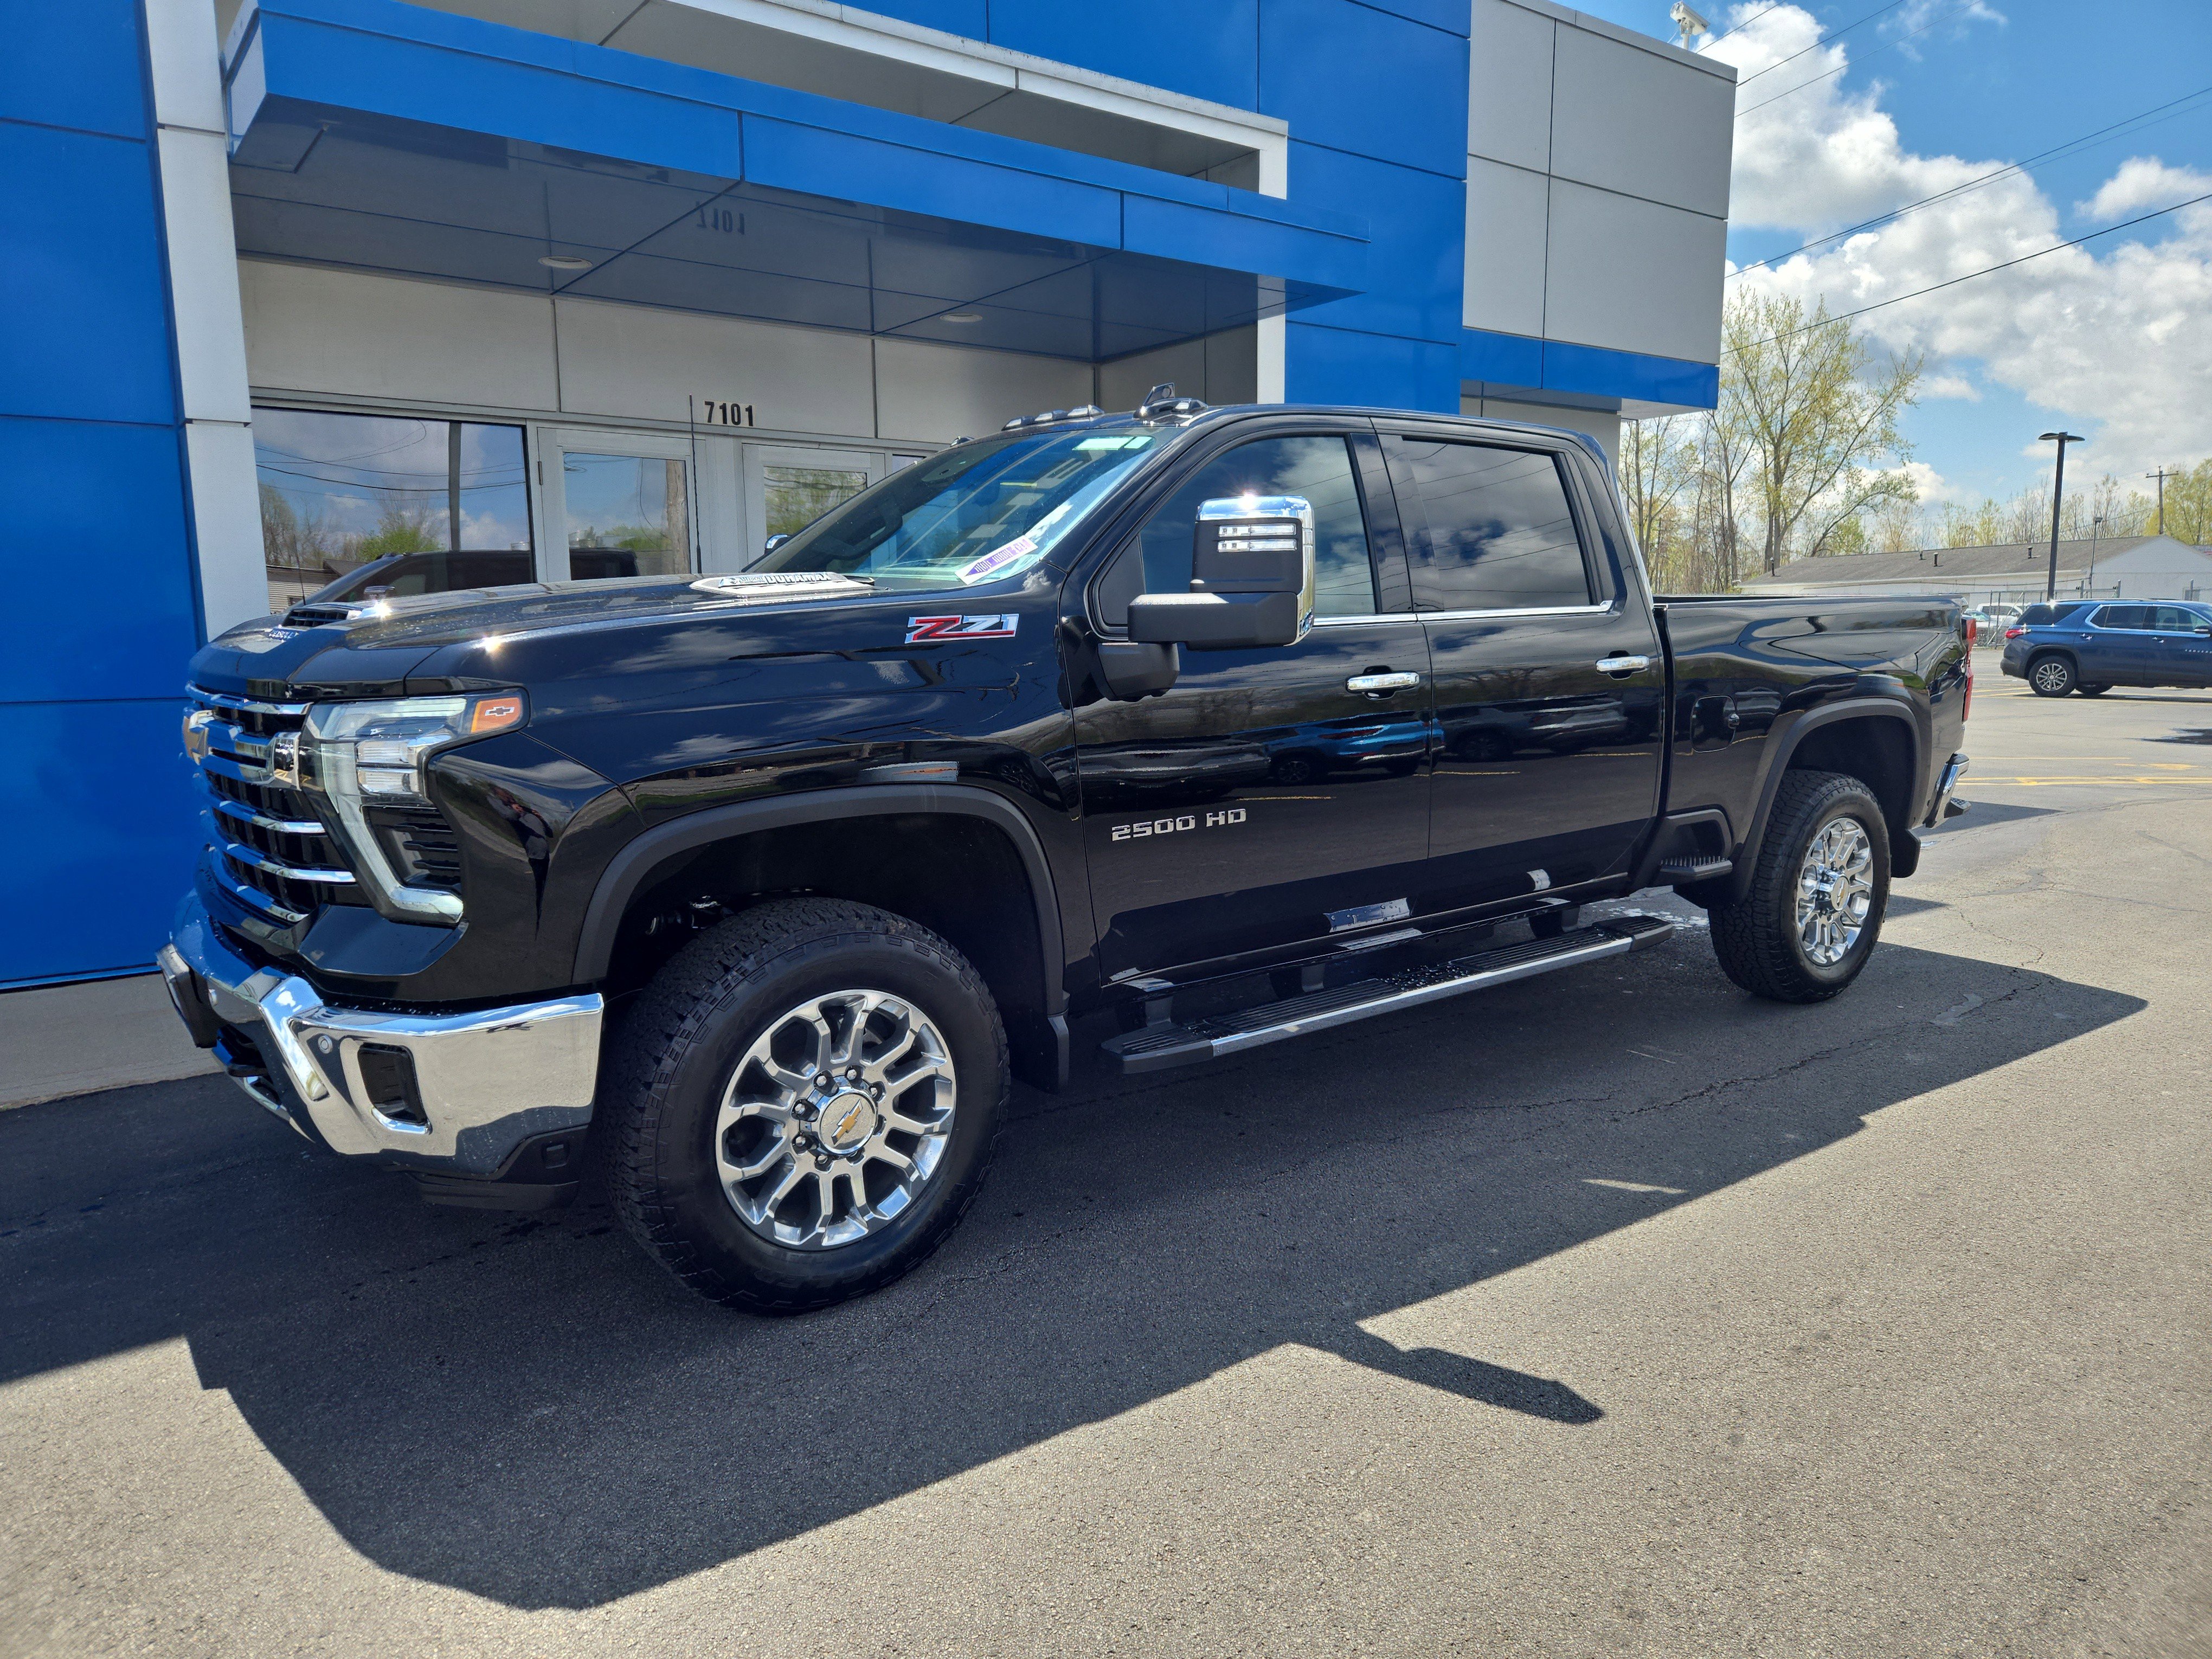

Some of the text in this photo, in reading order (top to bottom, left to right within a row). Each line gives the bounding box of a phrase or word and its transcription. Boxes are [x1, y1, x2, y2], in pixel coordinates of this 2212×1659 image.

[704, 401, 753, 427] 7101
[765, 573, 832, 584] DURAMAX
[904, 613, 1019, 644] Z71
[1111, 808, 1246, 841] 2500 HD
